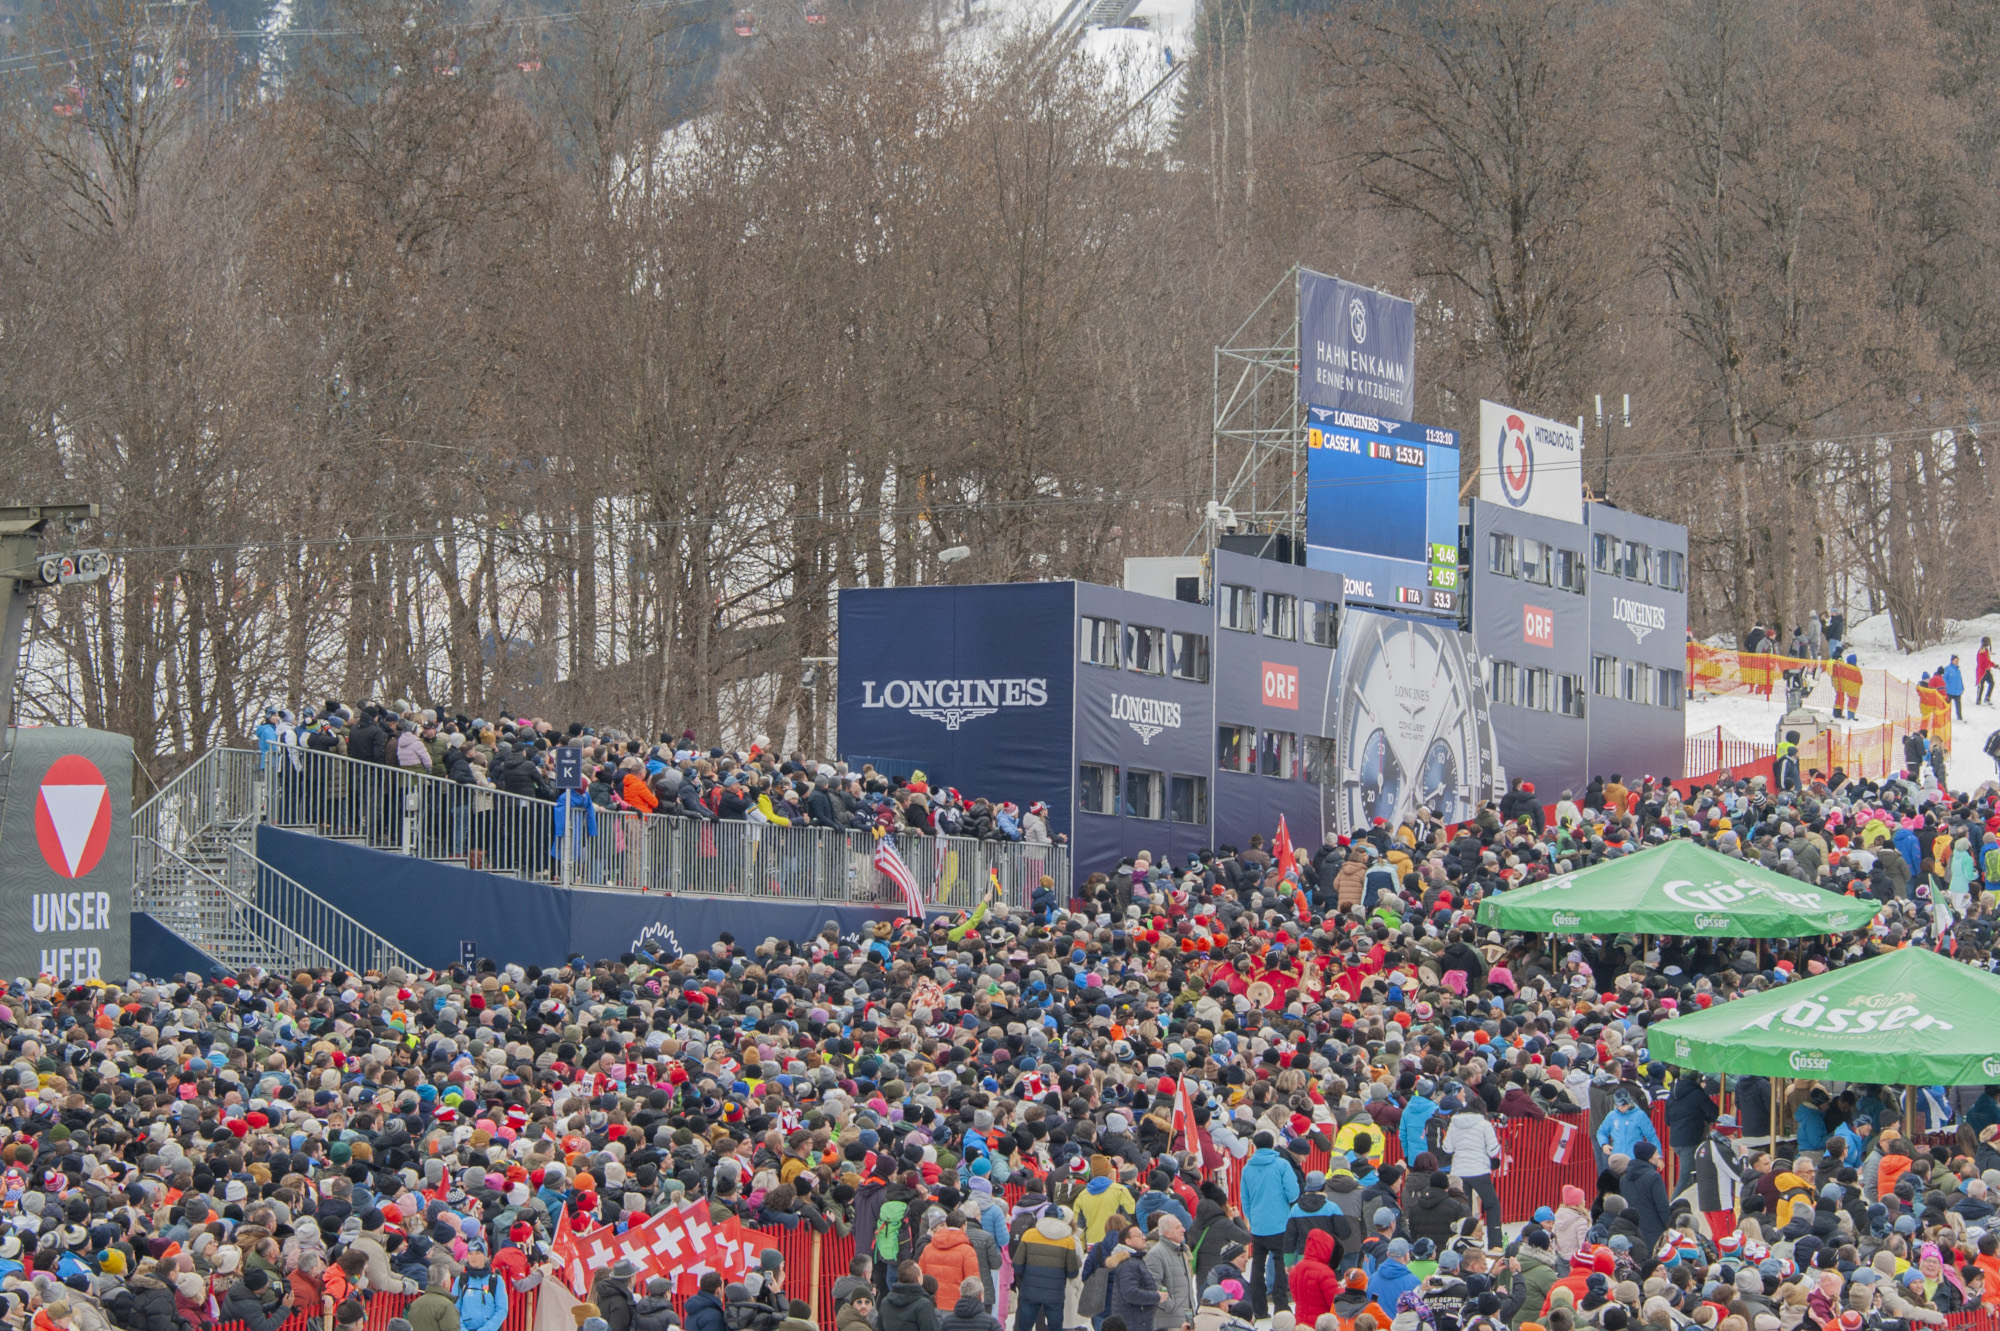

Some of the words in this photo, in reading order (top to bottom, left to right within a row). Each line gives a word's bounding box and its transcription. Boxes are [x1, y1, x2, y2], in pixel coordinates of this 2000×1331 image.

[1317, 340, 1404, 384] HAHNENKAMM
[1317, 368, 1354, 393] RENNEN
[1357, 379, 1403, 406] KITZBÜHEL
[1334, 411, 1379, 433] LONGINES
[1323, 433, 1350, 452] CASSE
[1350, 438, 1361, 455] M.
[1379, 445, 1392, 459] ITA
[1396, 447, 1424, 466] 1:53.71
[1426, 429, 1453, 446] 11:33:10
[1534, 426, 1565, 449] HITRADIO
[1565, 431, 1574, 452] Ö3
[1436, 547, 1456, 564] -0.46
[1436, 571, 1456, 587] -0.59
[1365, 582, 1374, 598] G.
[1408, 590, 1420, 604] ITA
[1434, 592, 1451, 609] 53.3
[1525, 612, 1552, 640] ORF
[1612, 597, 1666, 631] LONGINES
[862, 678, 1048, 708] LONGINES
[1264, 670, 1296, 700] ORF
[1110, 694, 1182, 729] LONGINES
[563, 767, 573, 778] K
[1367, 790, 1375, 803] 20
[1387, 793, 1394, 805] 10
[1445, 801, 1453, 813] 20
[32, 892, 110, 932] UNSER
[1552, 911, 1582, 928] Gösser
[1694, 913, 1730, 930] Gösser
[466, 961, 473, 972] K
[1789, 1050, 1831, 1071] Gösser
